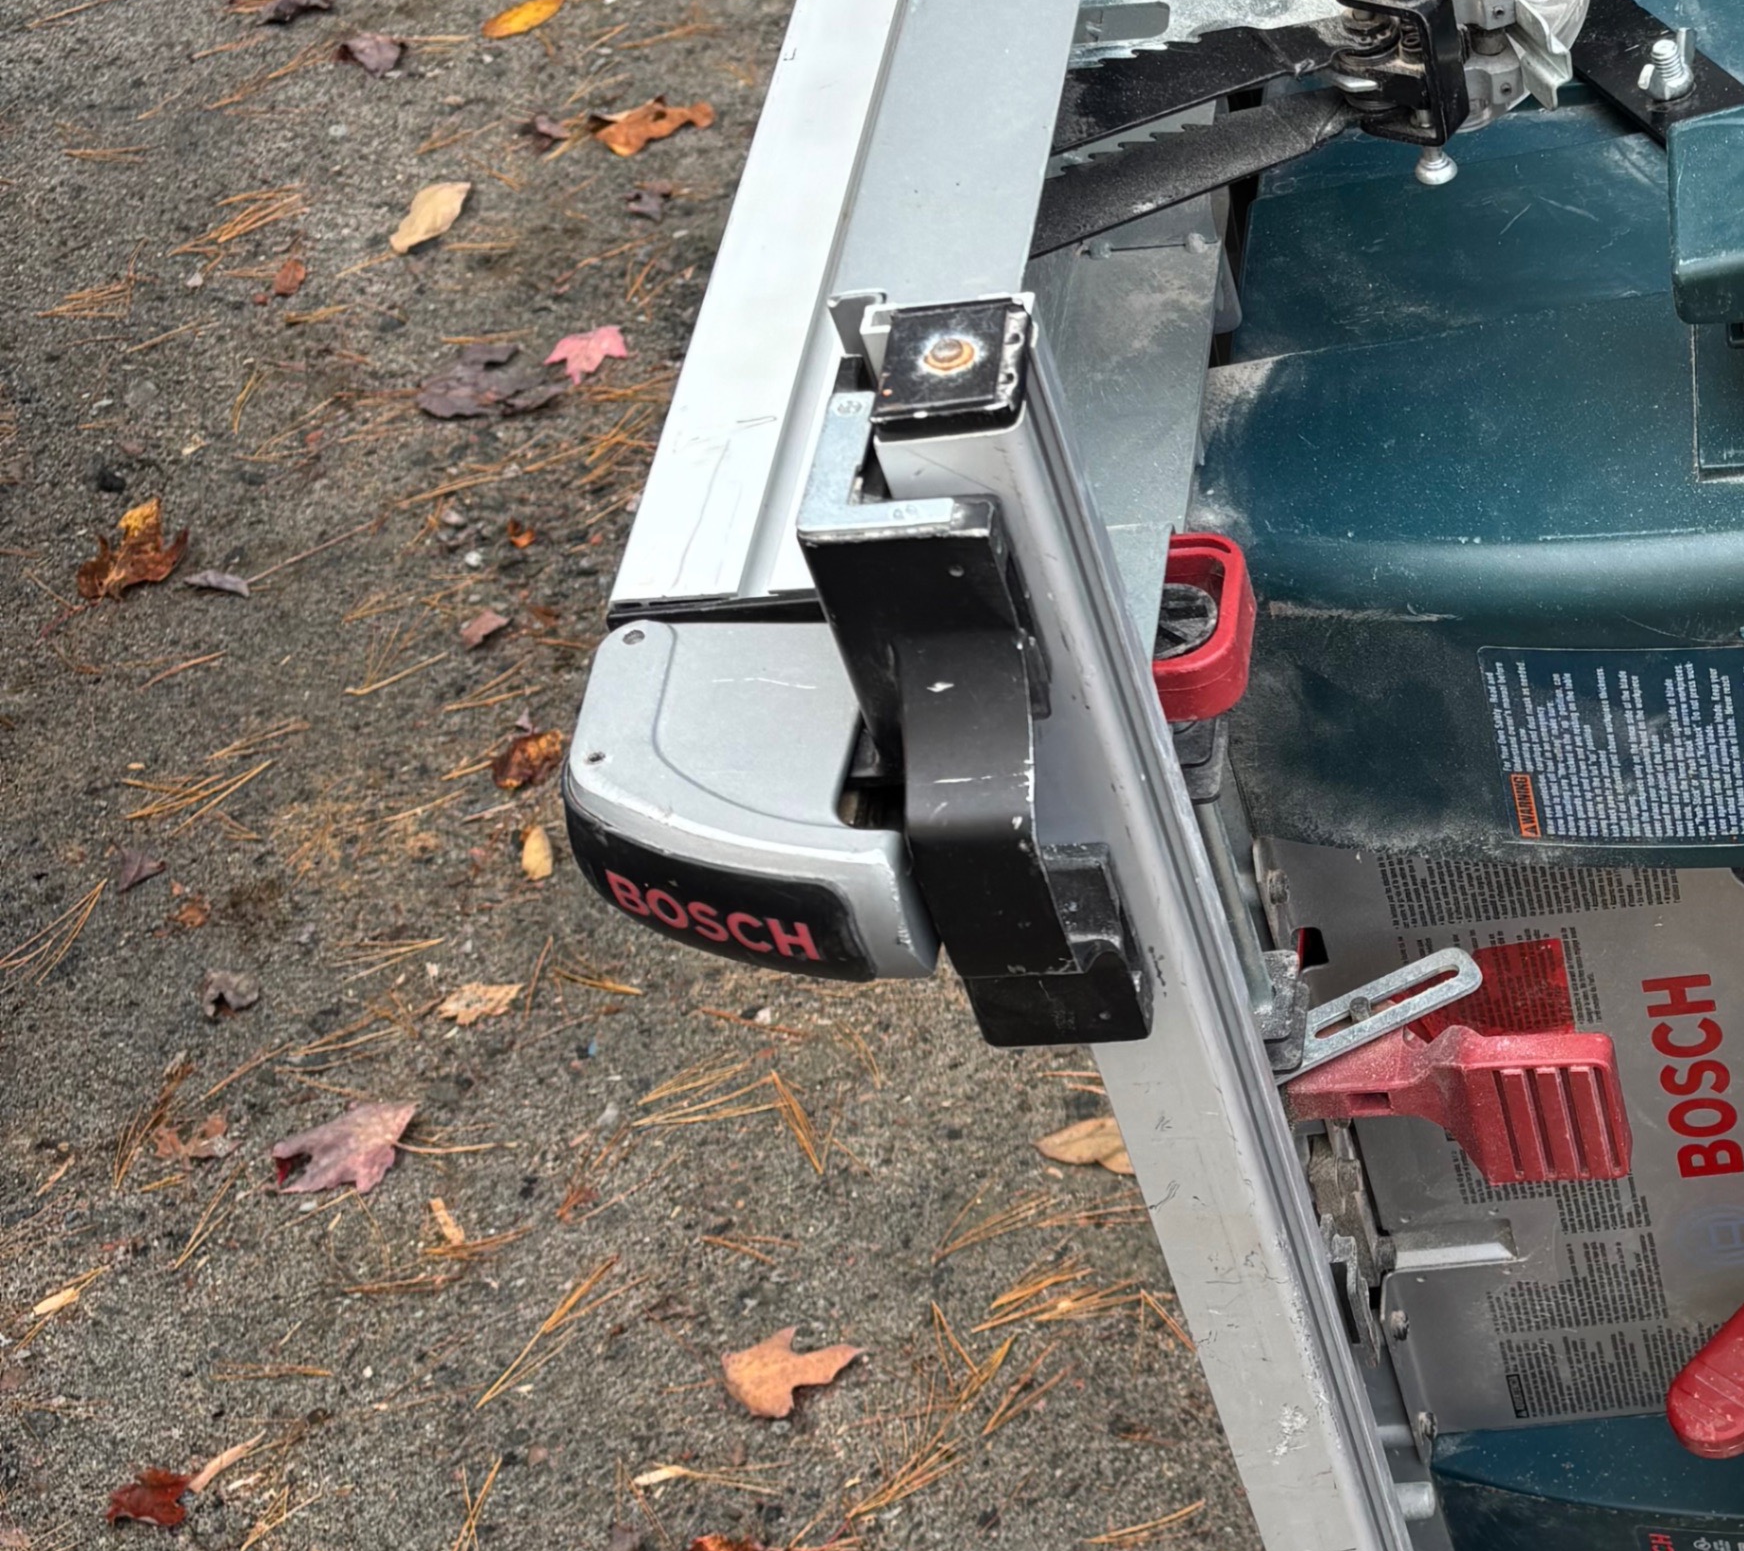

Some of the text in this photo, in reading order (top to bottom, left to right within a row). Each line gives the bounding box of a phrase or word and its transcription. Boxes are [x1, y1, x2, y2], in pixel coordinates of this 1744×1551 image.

[1485, 672, 1511, 771] For Your Own Safety Read and
[1495, 662, 1522, 771] Understand owner's manual before
[1514, 777, 1534, 823] WARNING
[605, 870, 819, 961] BOSCH
[1642, 974, 1744, 1178] BOSCH
